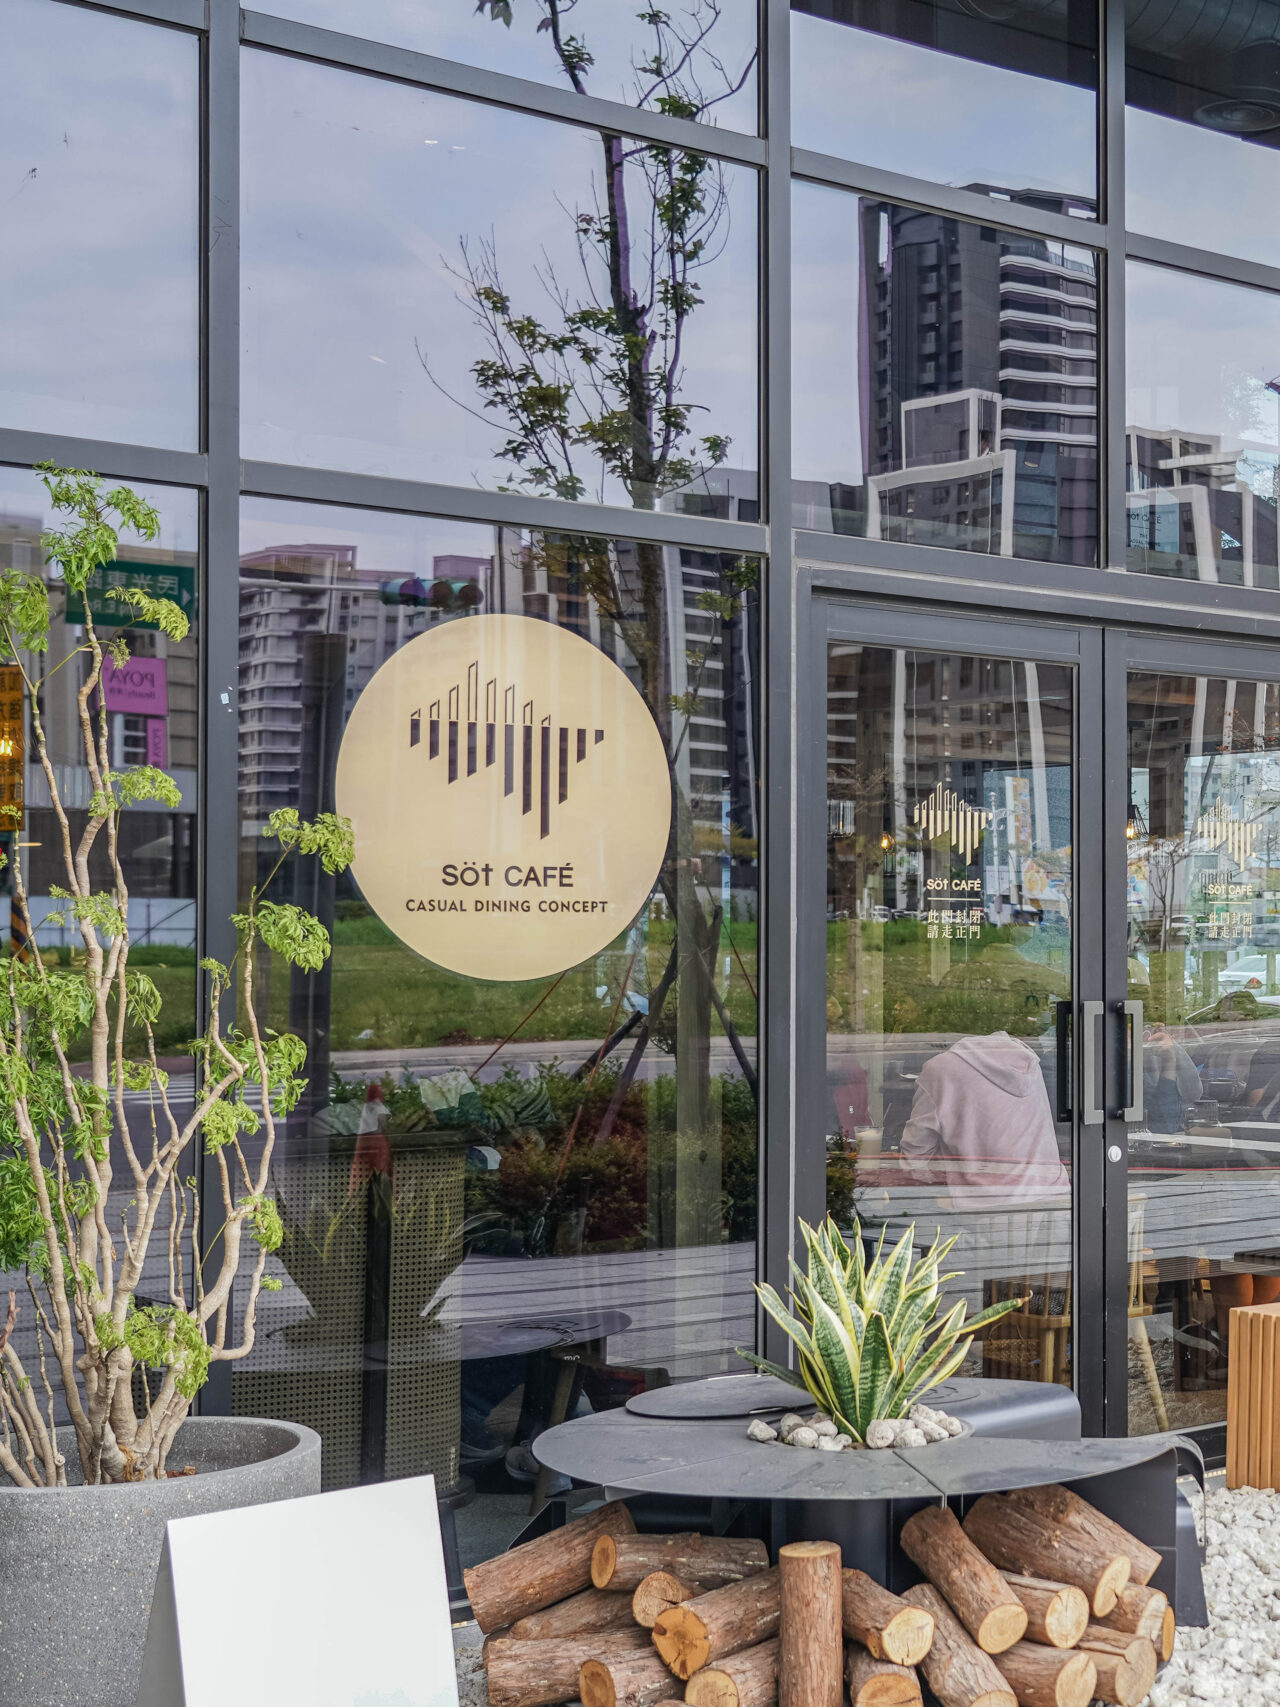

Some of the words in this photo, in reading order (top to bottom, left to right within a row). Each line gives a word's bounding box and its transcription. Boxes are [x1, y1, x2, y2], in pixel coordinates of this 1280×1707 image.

[504, 862, 574, 888] CAFÉ
[952, 878, 982, 892] CAFÉ
[1228, 884, 1253, 896] CAFÉ
[405, 899, 467, 913] CASUAL
[474, 900, 531, 913] DINING
[538, 900, 609, 913] CONCEPT
[927, 909, 981, 924] 此門封閉
[927, 924, 981, 940] 請走正門
[1208, 925, 1253, 939] 請走正門
